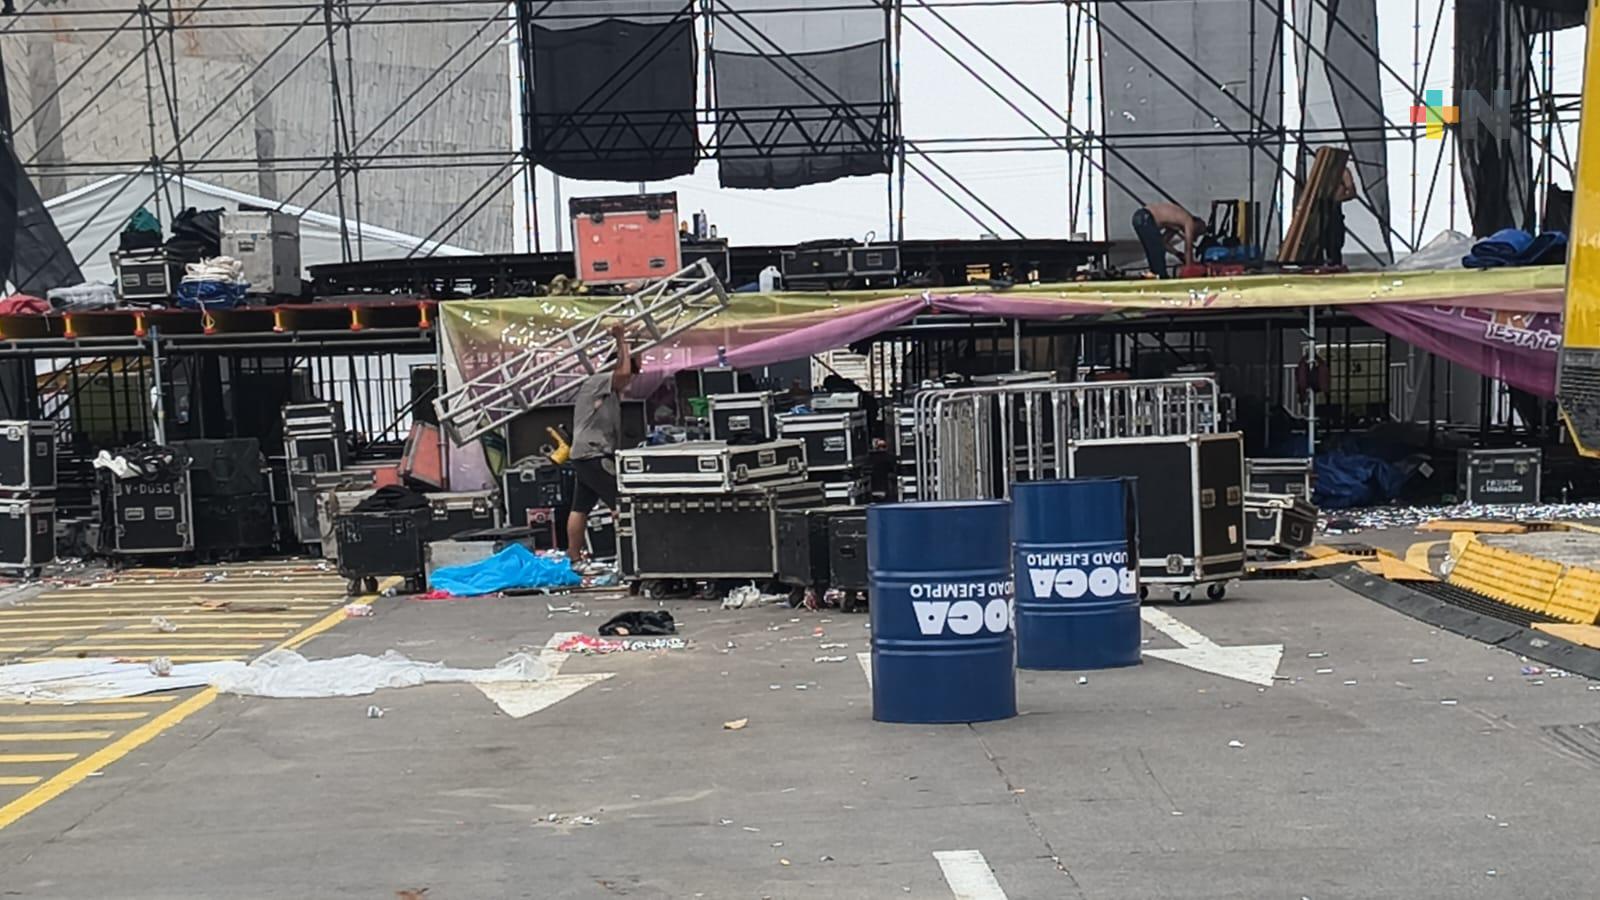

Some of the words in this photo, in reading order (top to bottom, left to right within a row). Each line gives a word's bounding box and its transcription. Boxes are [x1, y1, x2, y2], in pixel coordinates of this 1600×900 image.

[1027, 553, 1089, 566] EJEMPLO
[1029, 566, 1137, 598] BOCA
[910, 583, 985, 598] EJEMPLO
